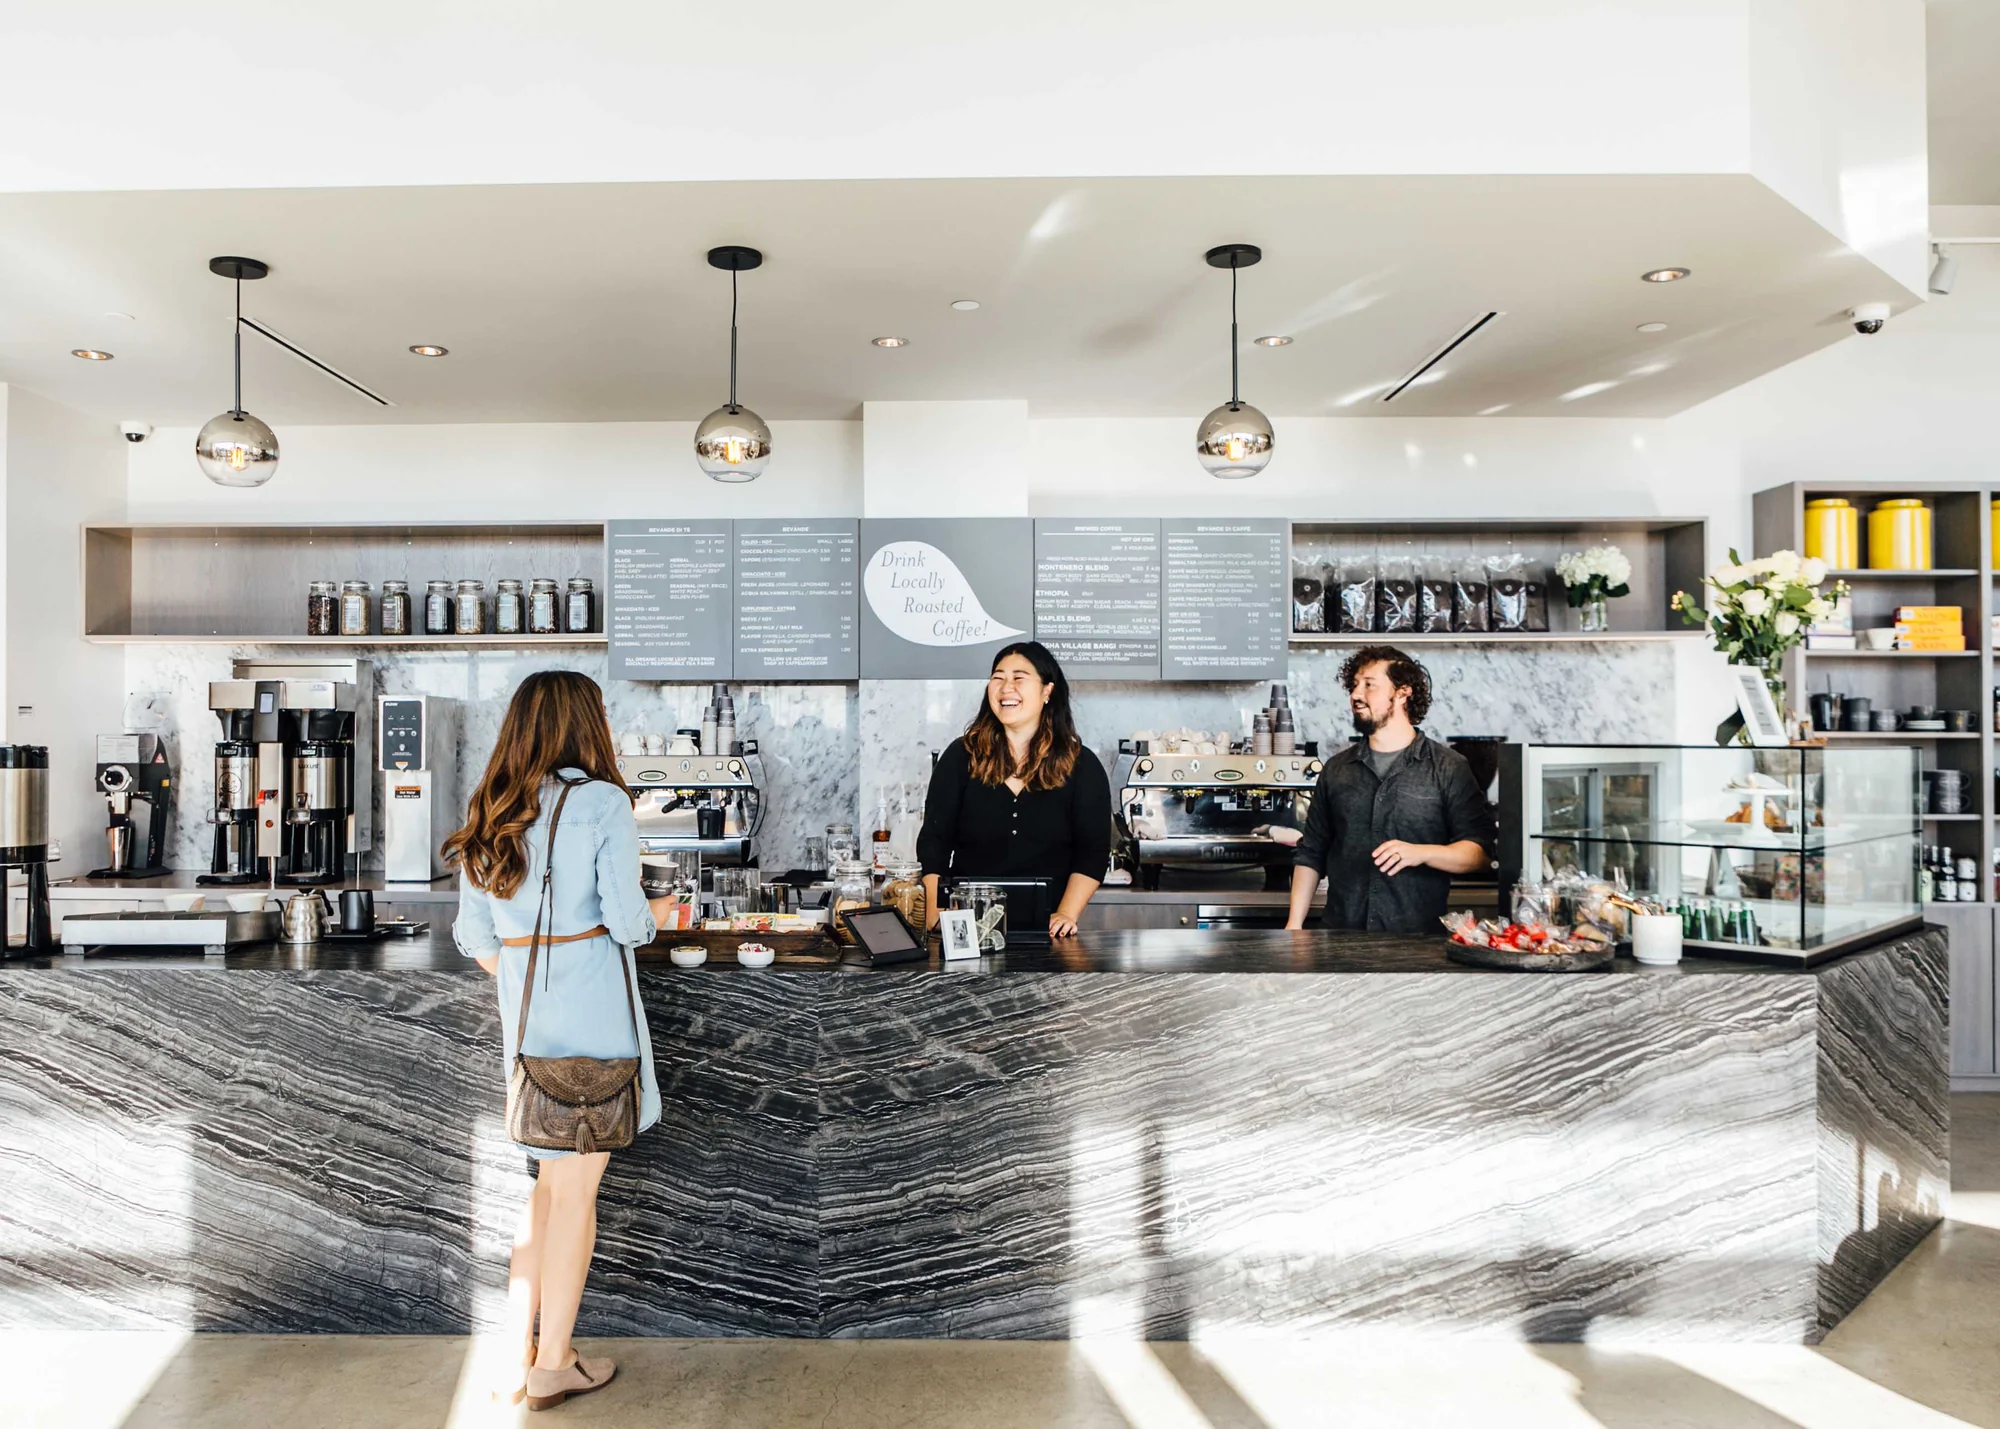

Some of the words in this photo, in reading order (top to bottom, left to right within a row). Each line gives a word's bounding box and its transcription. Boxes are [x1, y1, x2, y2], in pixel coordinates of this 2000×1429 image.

[881, 550, 926, 567] Drink
[891, 572, 945, 595] Locally
[904, 596, 964, 613] Roasted
[933, 620, 988, 643] Coffee!
